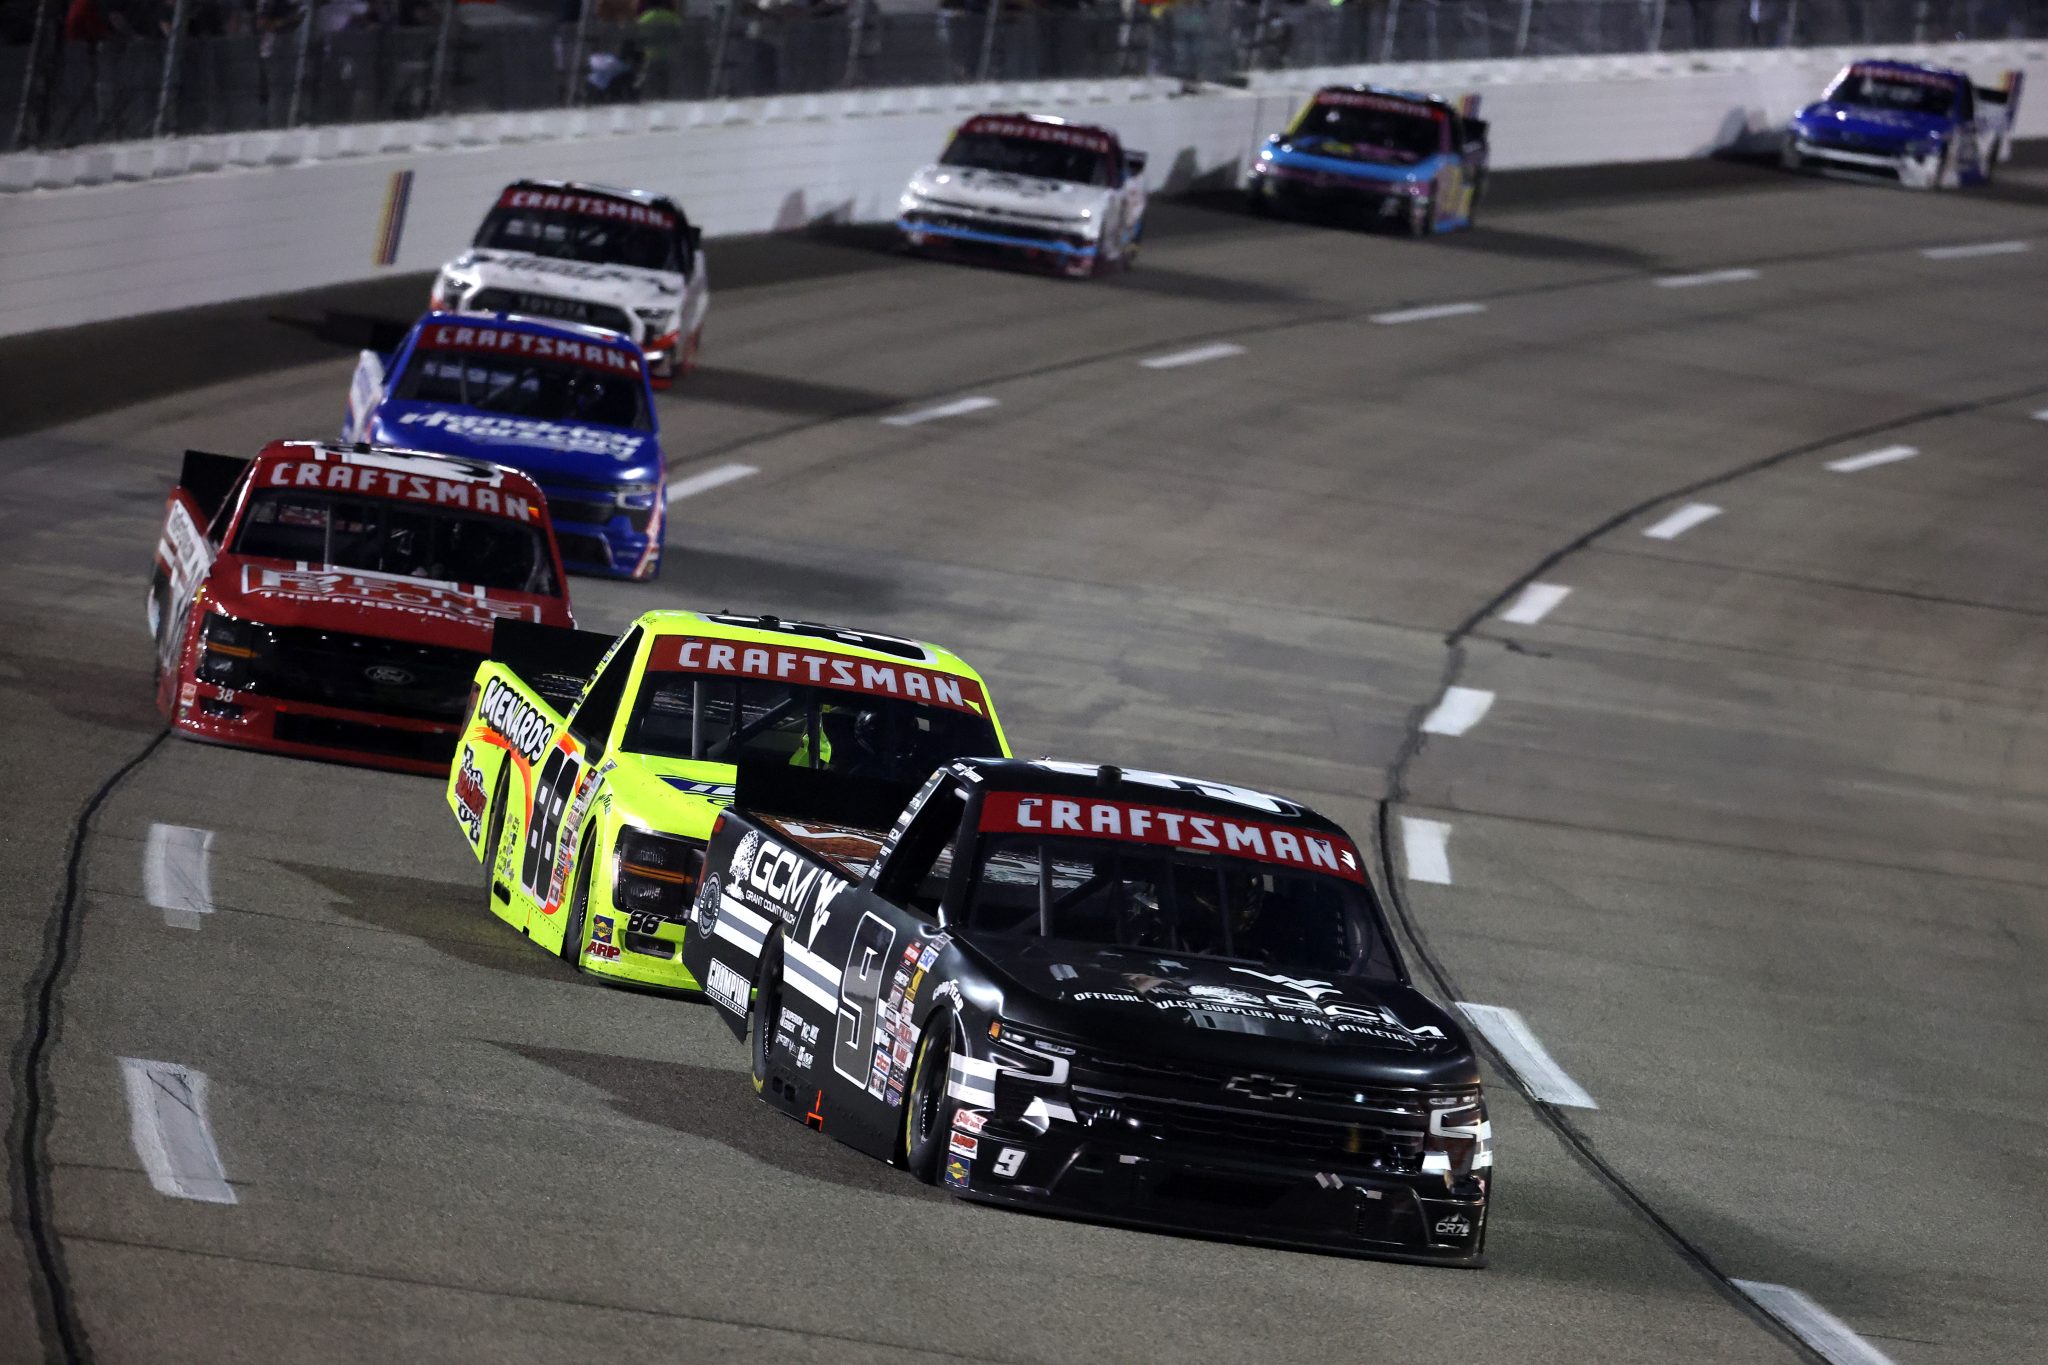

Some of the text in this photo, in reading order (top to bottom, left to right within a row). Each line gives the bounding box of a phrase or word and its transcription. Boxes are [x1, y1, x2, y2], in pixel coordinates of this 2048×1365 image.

[511, 190, 665, 226] CRAFTSMAN
[436, 327, 627, 370] CRAFTSMAN
[270, 462, 531, 522] CRAFTSMAN
[215, 685, 235, 703] 38
[678, 641, 964, 707] CRAFTSMAN
[480, 676, 555, 767] MENARDS
[520, 744, 585, 909] 88
[1016, 798, 1340, 871] CRAFTSMAN
[751, 840, 819, 912] GCM
[627, 909, 669, 935] 88
[745, 889, 764, 908] GRANT
[764, 901, 783, 917] COUNTY
[584, 940, 621, 959] ARP
[707, 959, 750, 1011] CHAMPION
[832, 911, 897, 1091] 9
[1073, 991, 1144, 1003] OFFICIAL
[1200, 1002, 1275, 1020] SUPPLIER
[1280, 1013, 1296, 1022] OF
[1301, 1017, 1332, 1031] WVU
[993, 1147, 1028, 1179] 9
[1435, 1222, 1464, 1234] CR7
